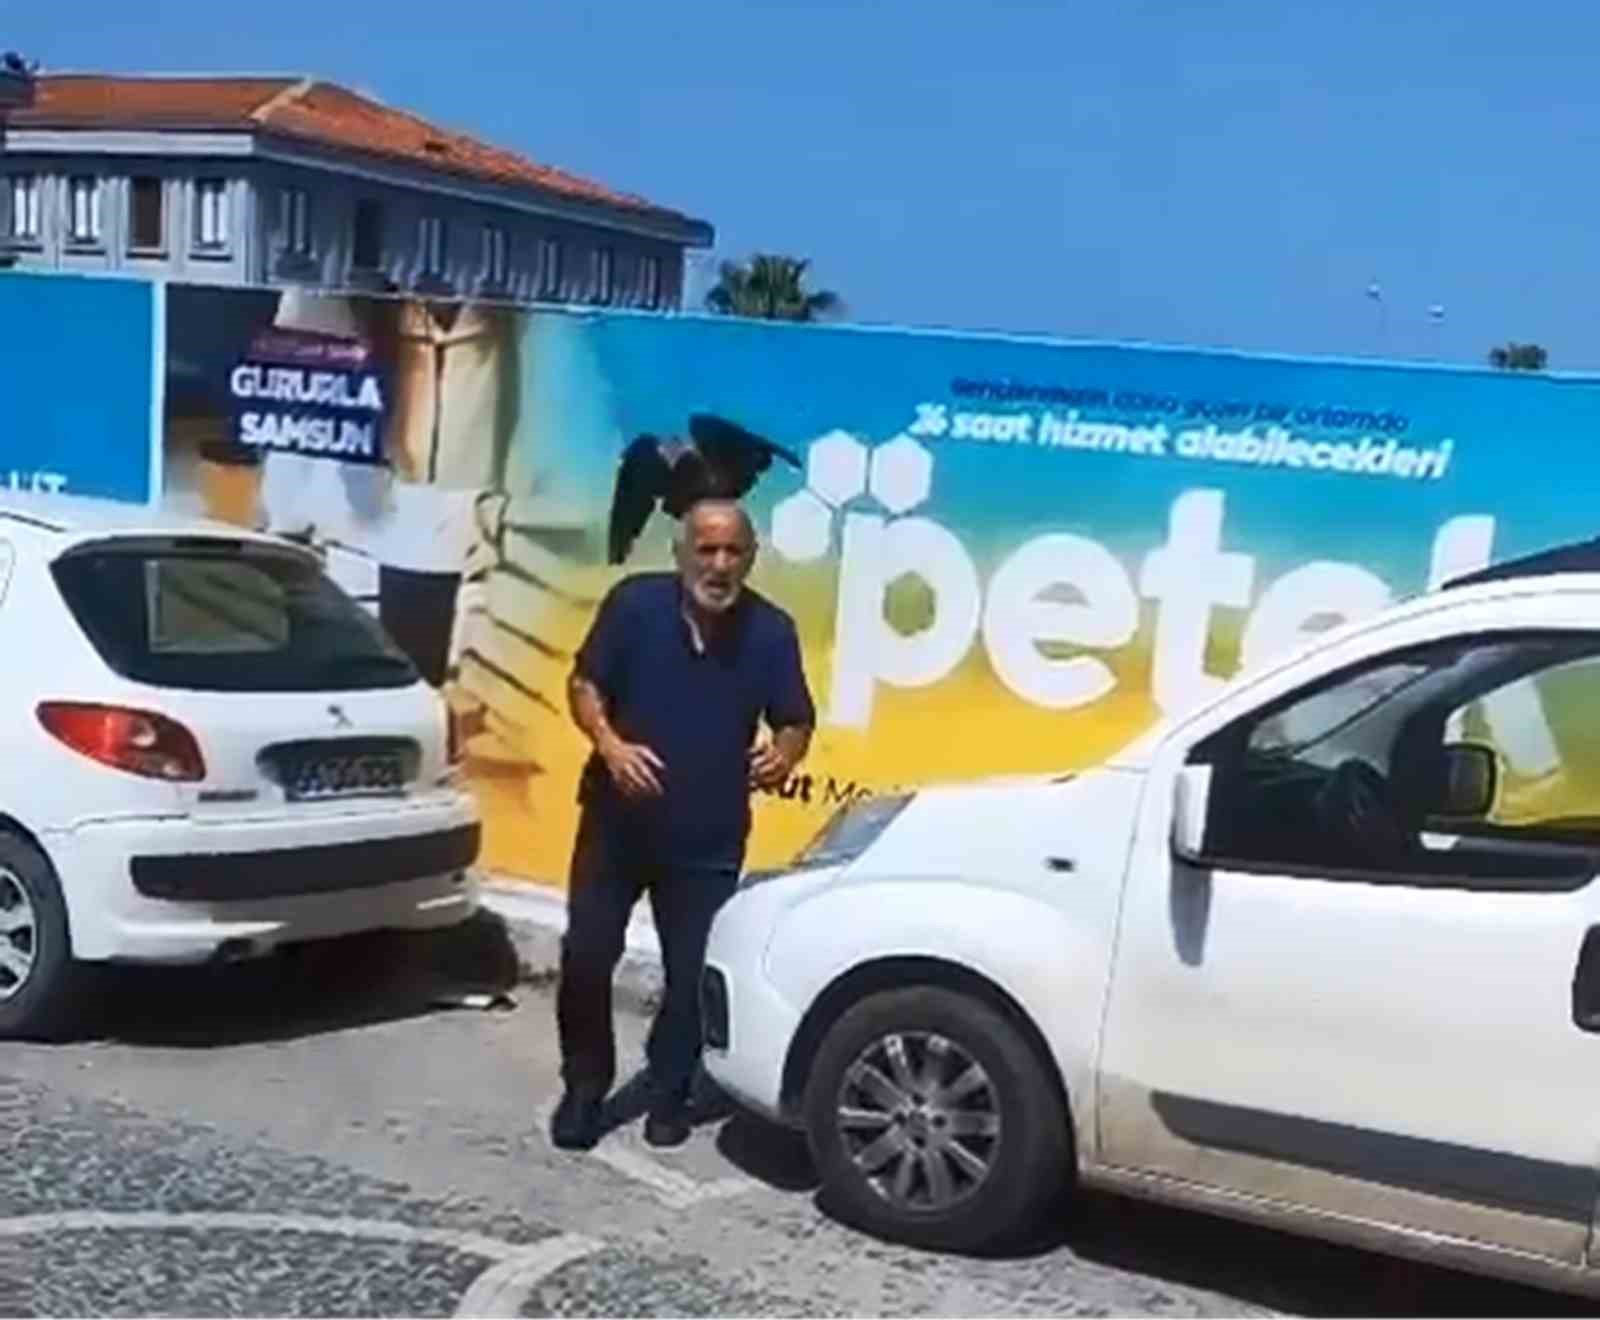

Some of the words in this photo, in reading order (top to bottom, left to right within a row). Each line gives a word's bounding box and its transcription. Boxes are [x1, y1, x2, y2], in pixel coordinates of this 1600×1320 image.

[231, 366, 382, 411] GURURLA
[240, 412, 374, 455] SAMSUN
[950, 411, 1032, 444] saat
[1037, 408, 1170, 455] hizmet
[827, 488, 1497, 740] pete
